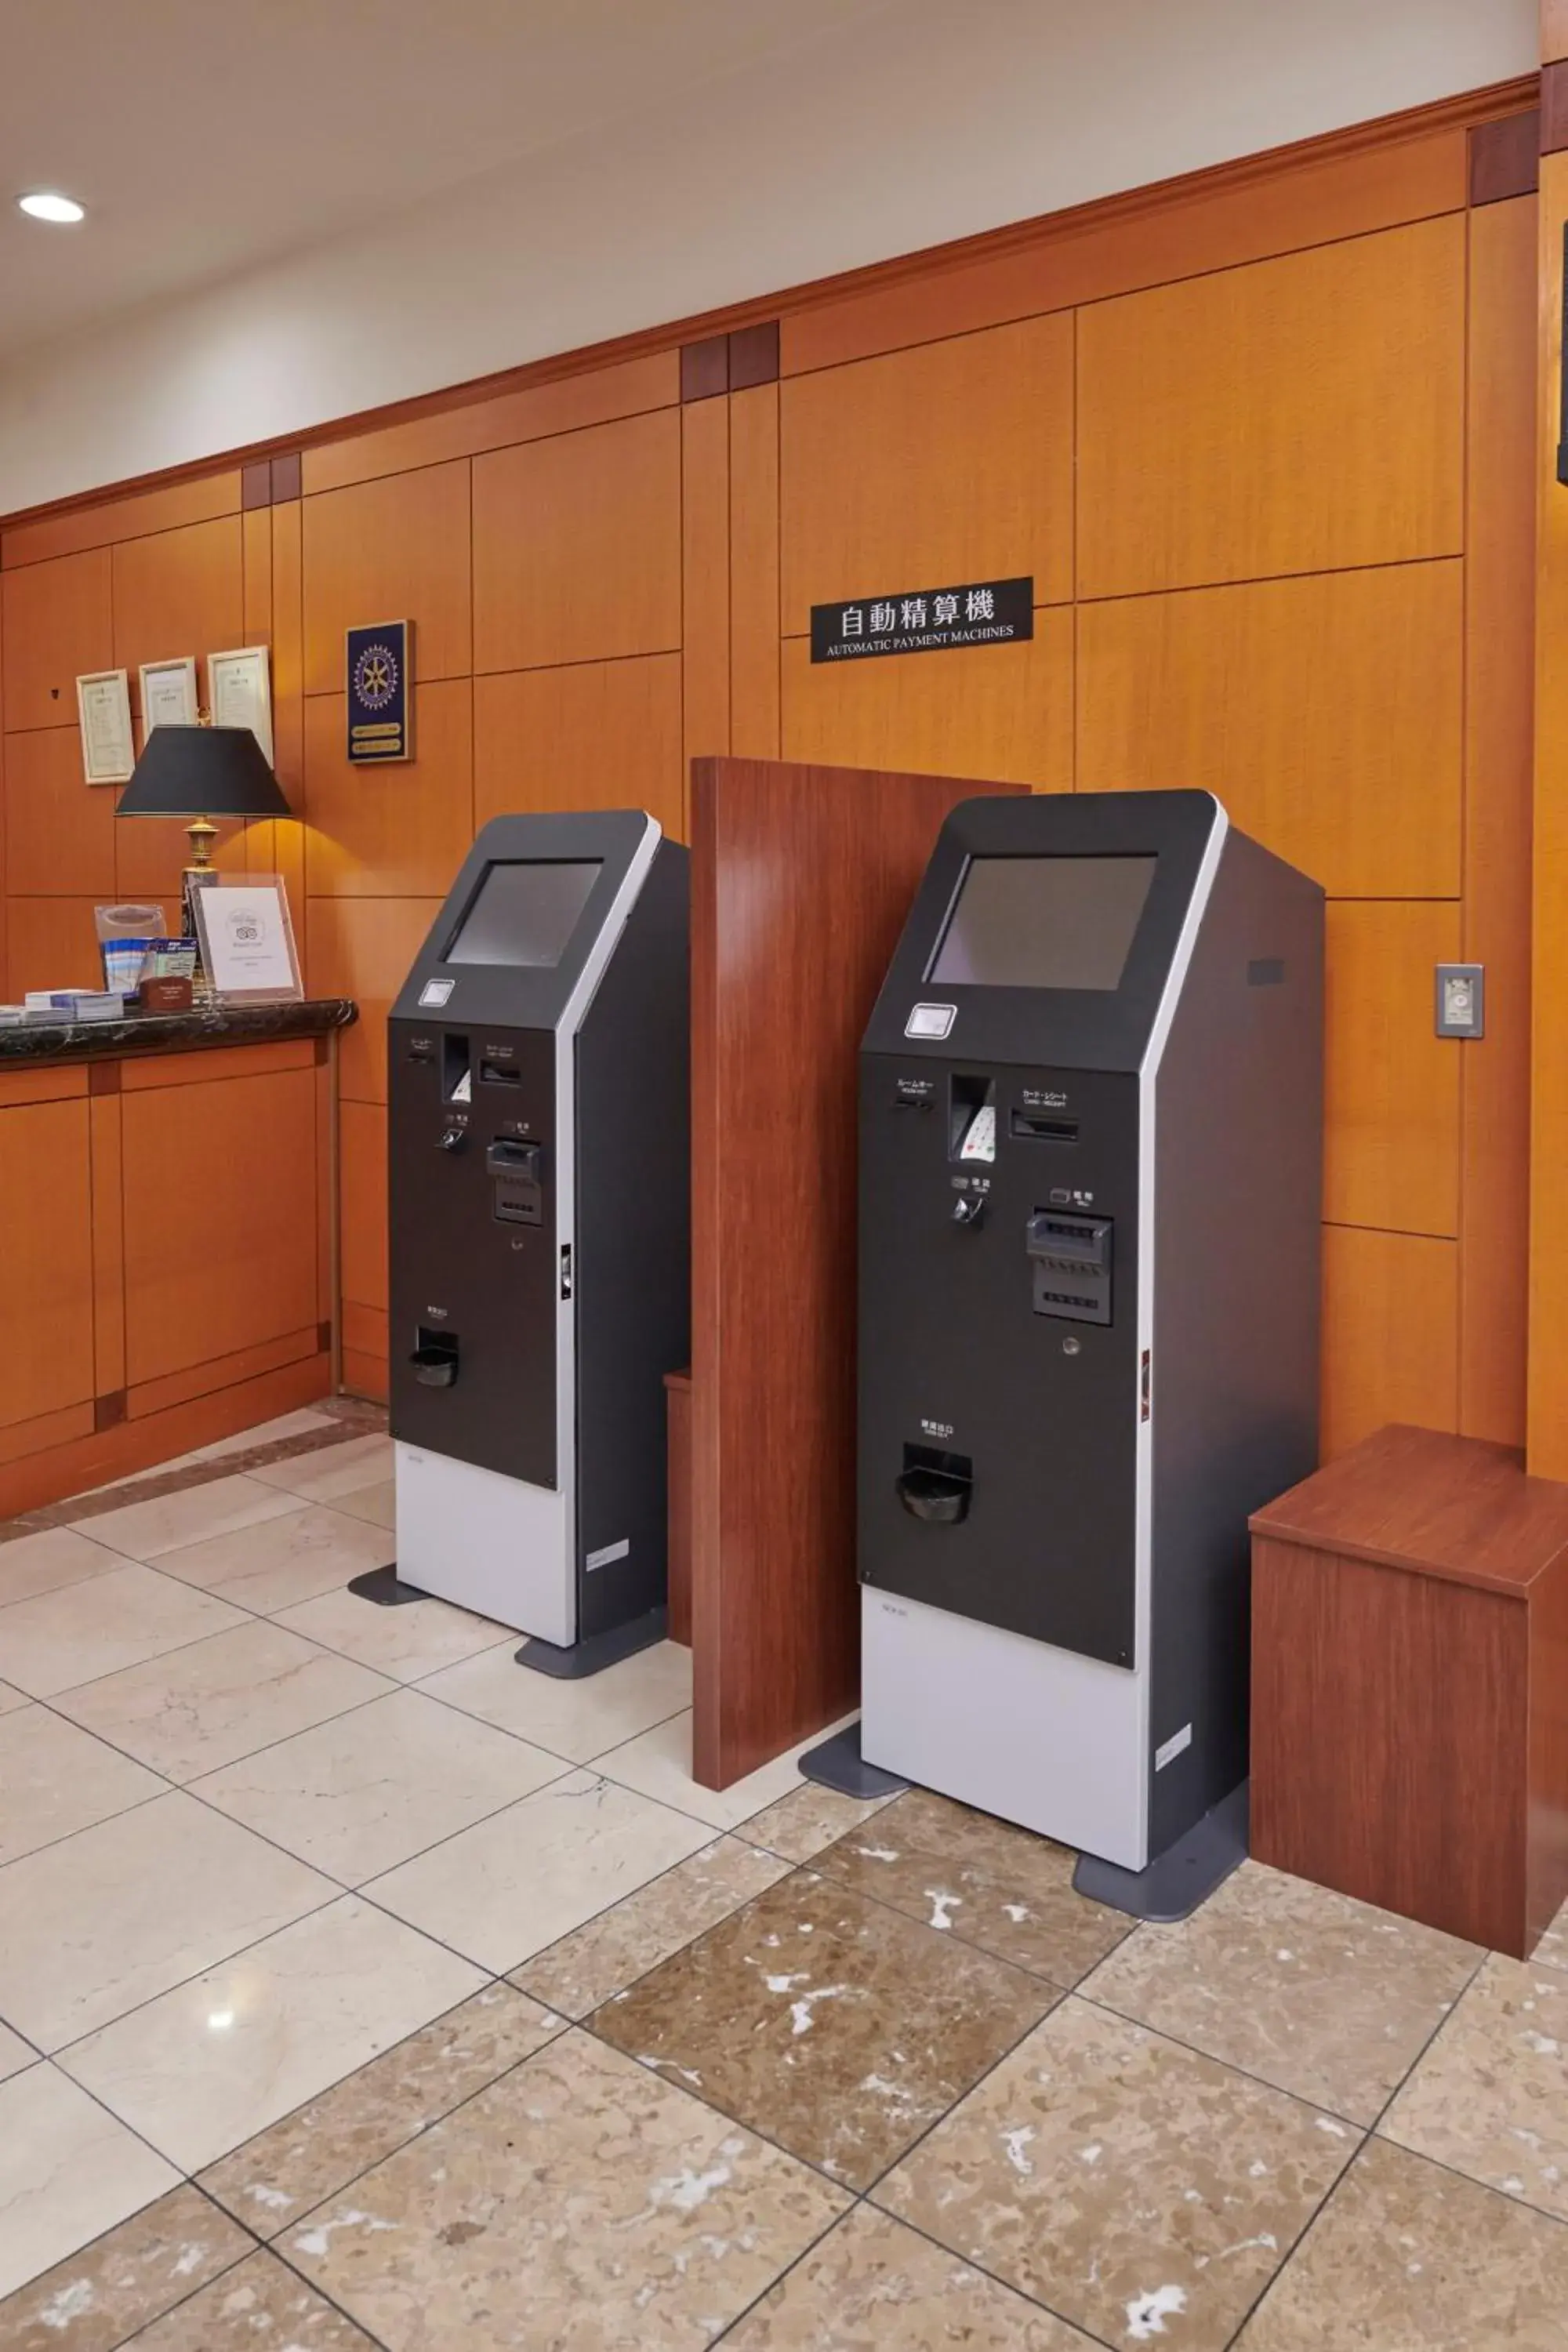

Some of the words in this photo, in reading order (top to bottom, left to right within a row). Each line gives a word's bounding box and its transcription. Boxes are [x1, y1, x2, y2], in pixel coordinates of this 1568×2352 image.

[842, 590, 994, 637] 自動精算機
[827, 640, 891, 656] AUTOMATIC
[893, 633, 948, 649] PAYMENT
[951, 625, 1014, 643] MACHINES
